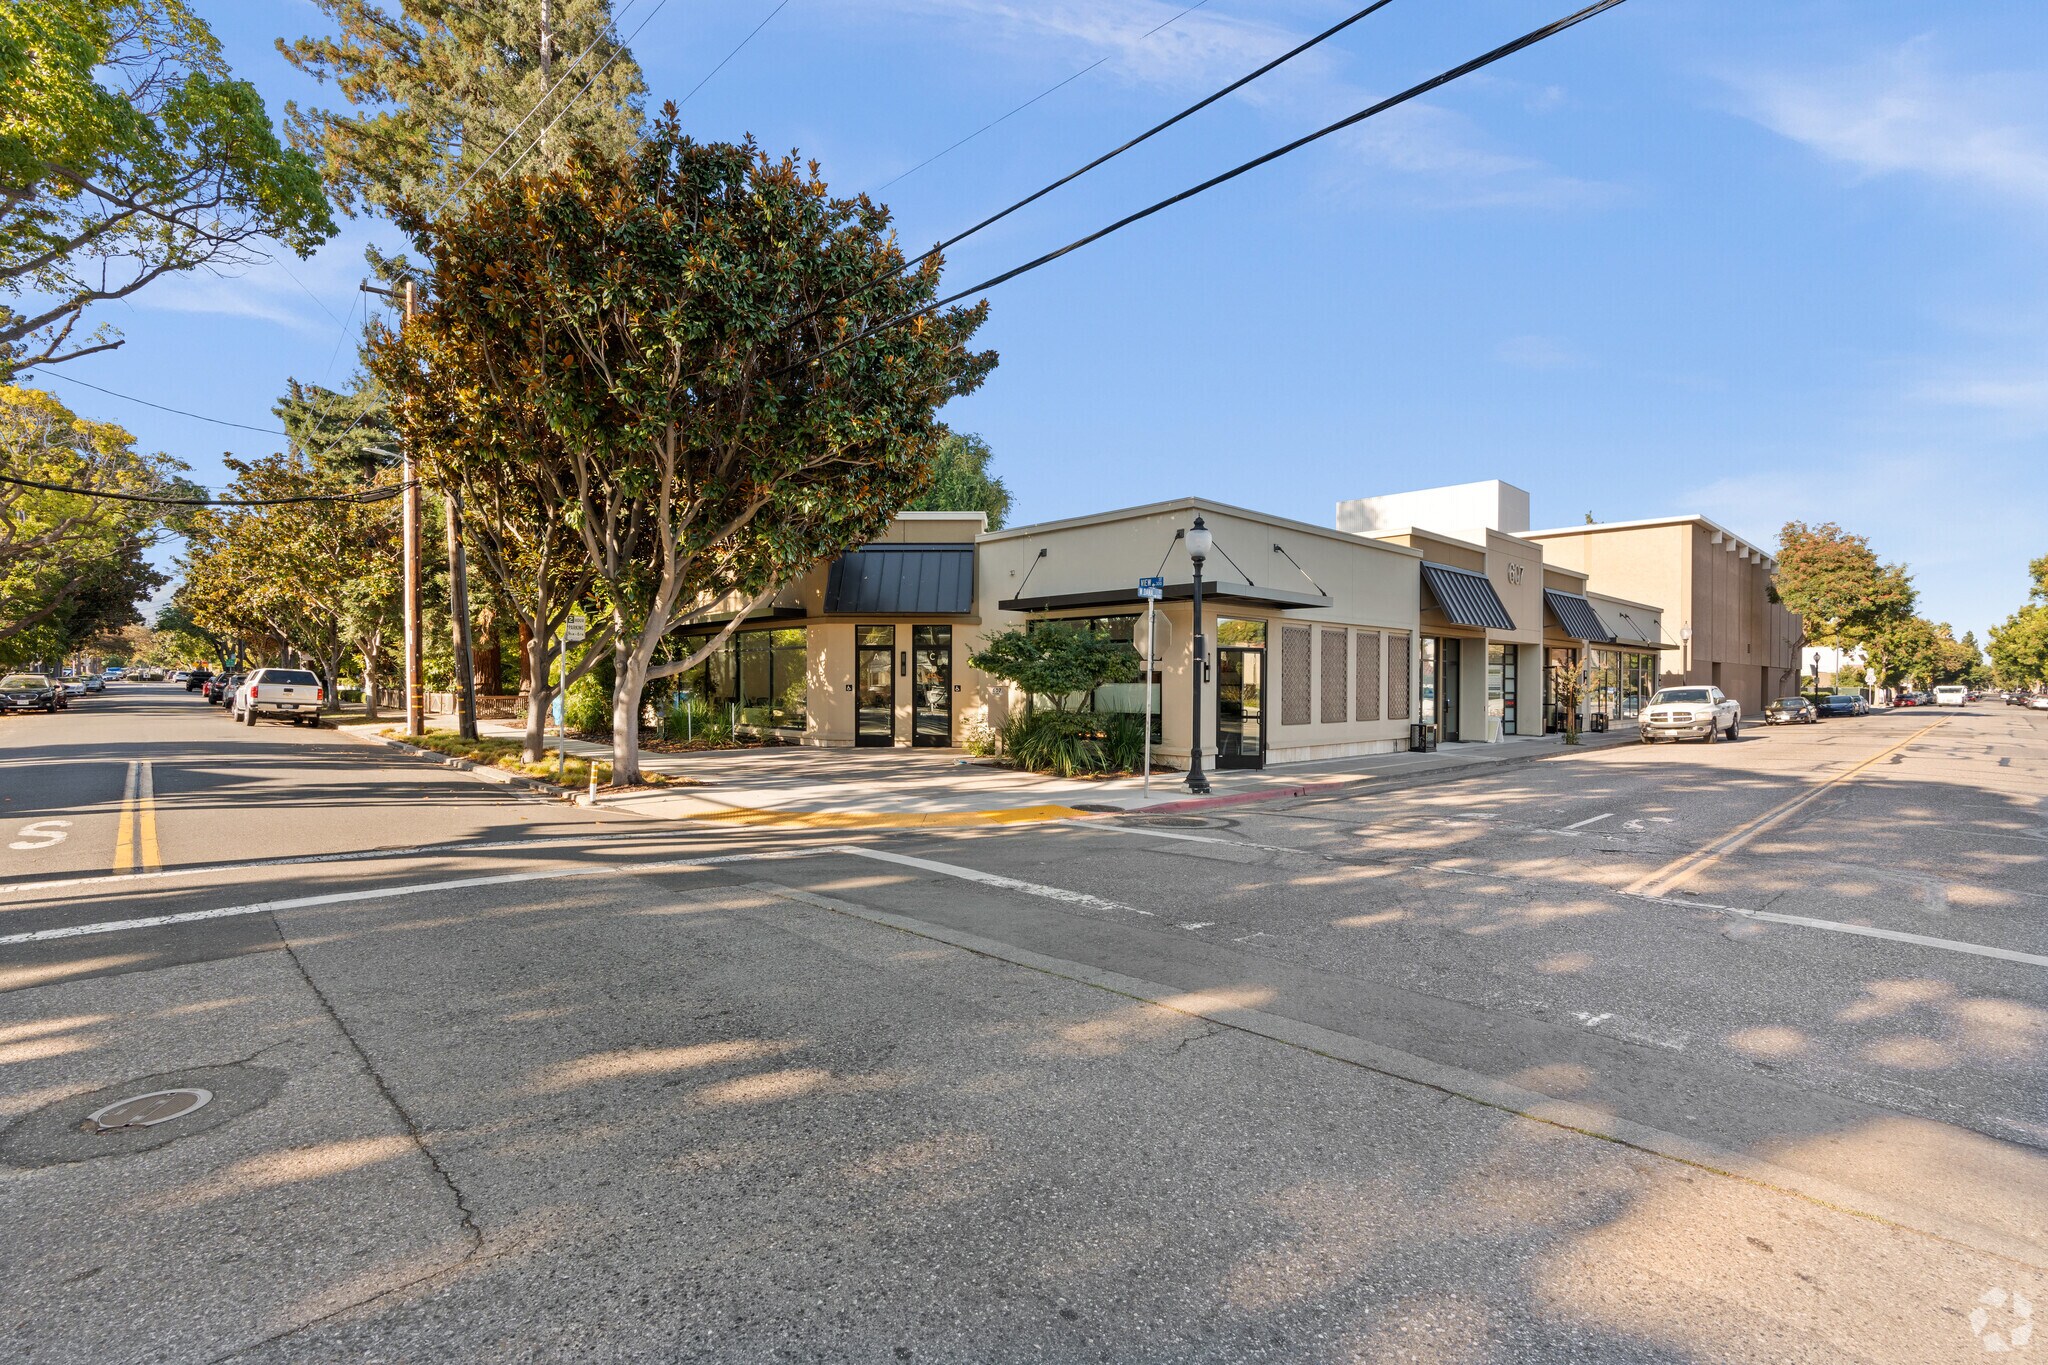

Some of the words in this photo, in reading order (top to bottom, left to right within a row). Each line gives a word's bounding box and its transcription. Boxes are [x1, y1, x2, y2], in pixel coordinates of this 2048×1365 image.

[1508, 562, 1524, 585] 607
[1140, 579, 1152, 587] VIEW
[873, 653, 880, 661] A
[929, 652, 936, 661] C
